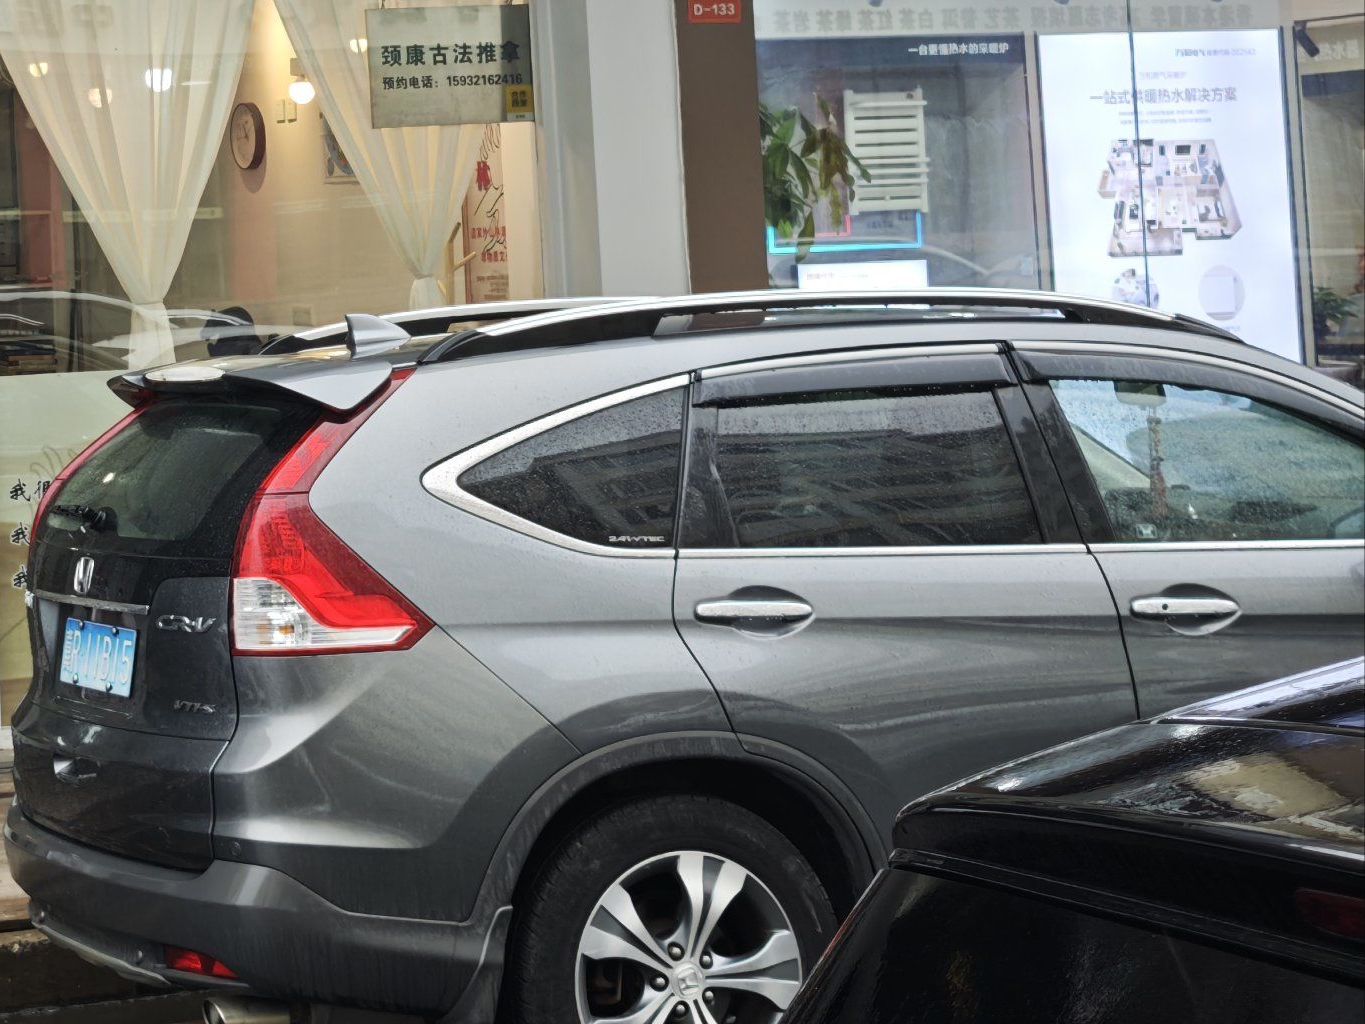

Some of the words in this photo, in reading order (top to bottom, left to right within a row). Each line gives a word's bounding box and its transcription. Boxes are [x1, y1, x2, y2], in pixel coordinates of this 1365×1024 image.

[693, 4, 735, 16] D-133
[380, 40, 521, 67] 颈康古法推拿
